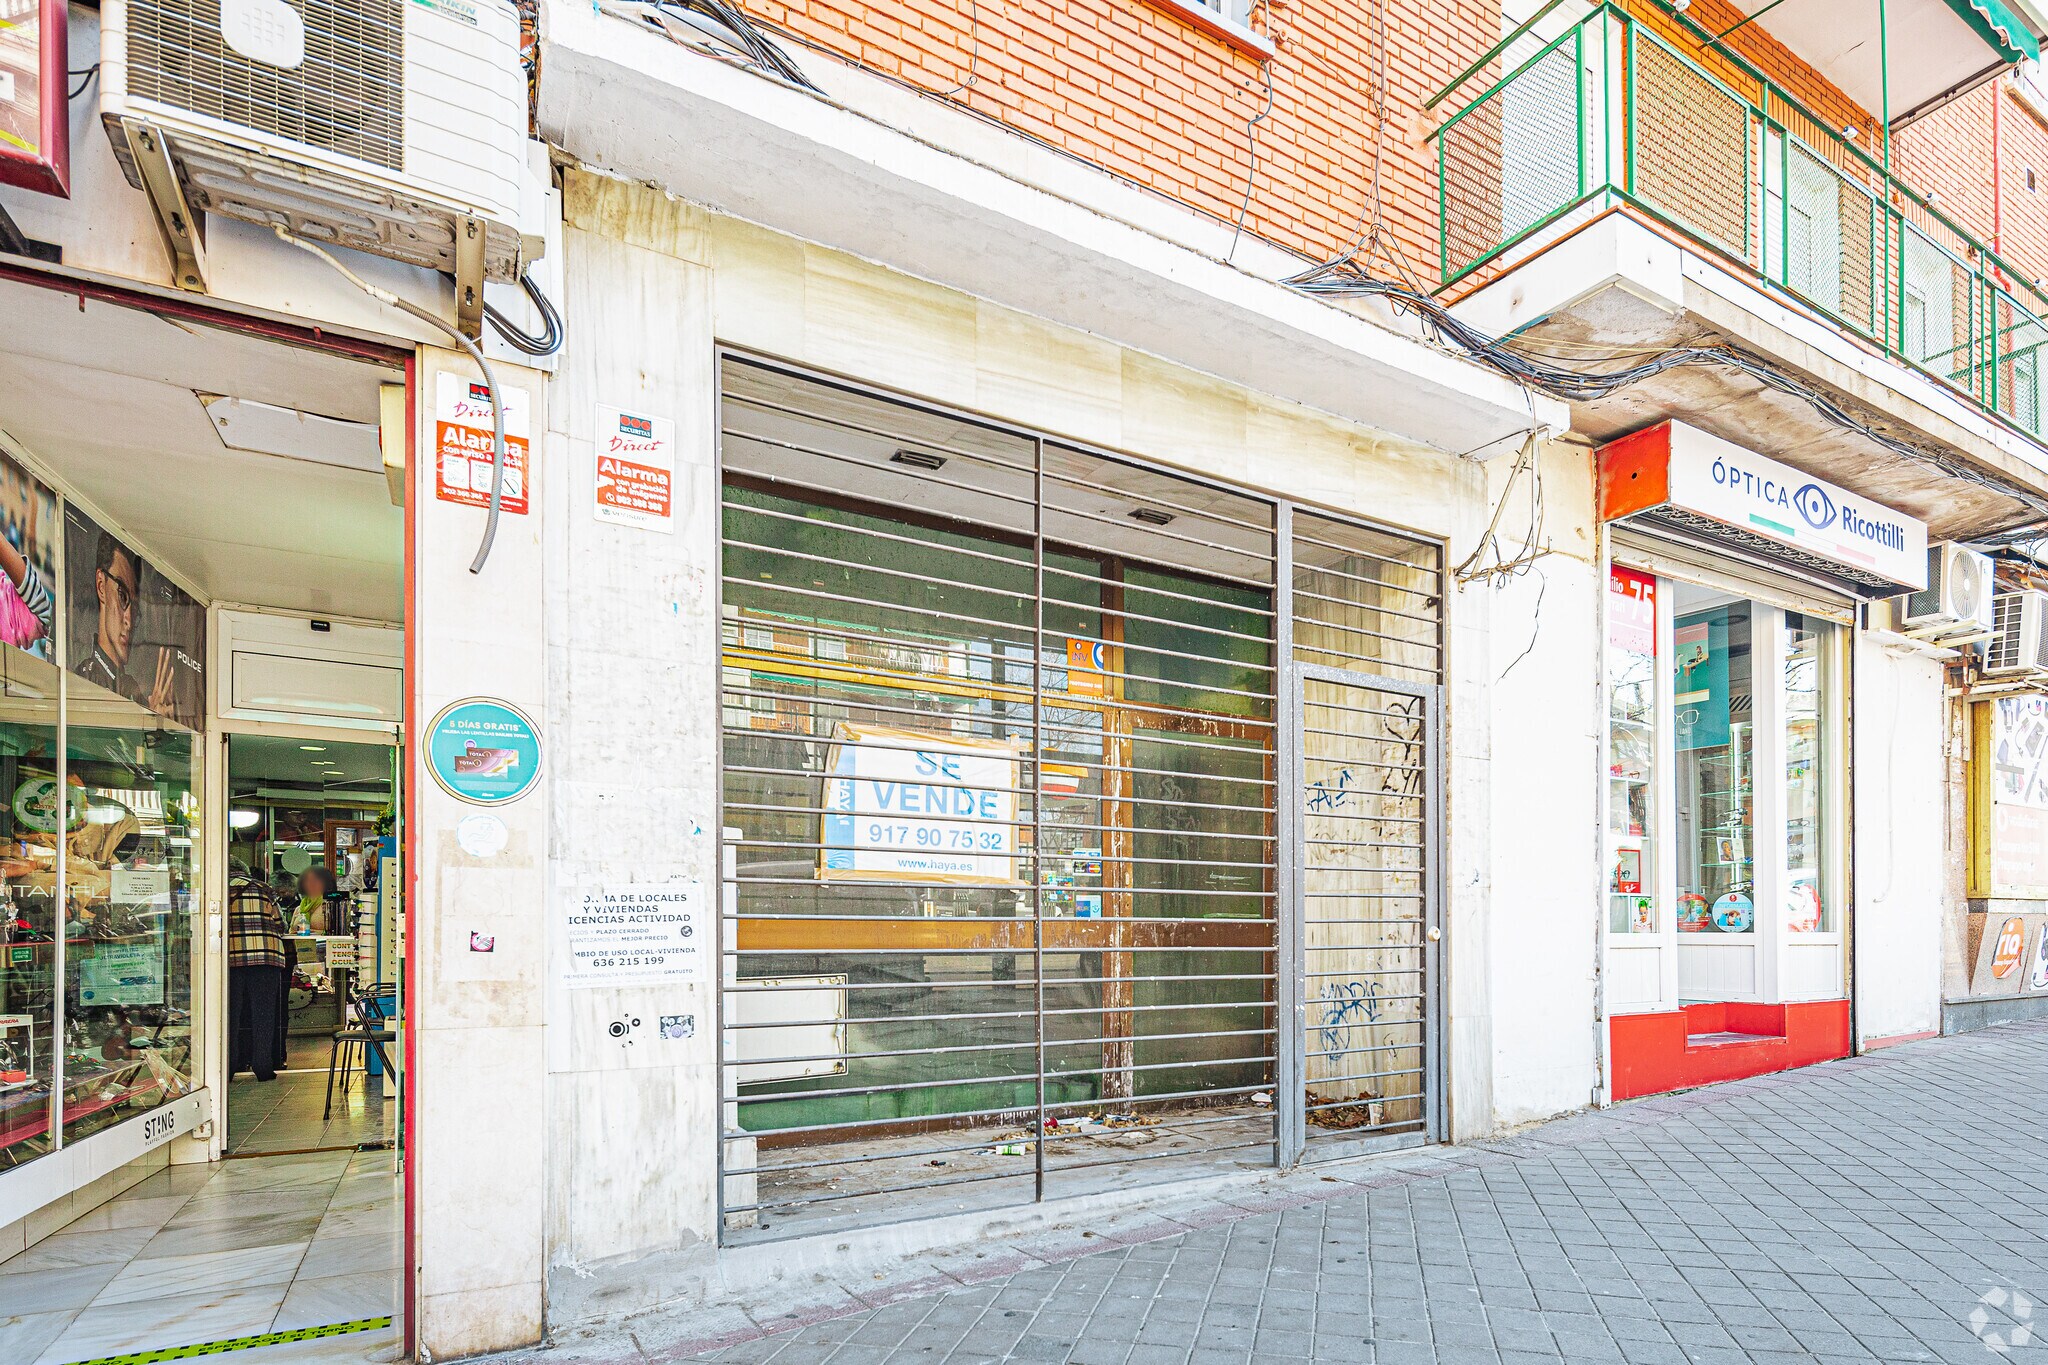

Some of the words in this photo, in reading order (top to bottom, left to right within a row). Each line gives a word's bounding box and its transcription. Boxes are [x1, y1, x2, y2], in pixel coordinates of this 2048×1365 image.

[620, 426, 652, 438] SECURITAS
[609, 436, 665, 452] Direct
[600, 459, 668, 486] Alarma
[1712, 456, 1790, 509] ÓPTICA
[1842, 505, 1905, 552] Ricottilli
[1630, 579, 1654, 625] 75
[177, 650, 202, 673] POLICE
[449, 720, 456, 728] 5
[457, 719, 481, 729] DÍAS
[915, 751, 961, 780] SE
[873, 781, 998, 819] VENDE
[869, 824, 909, 844] 917
[916, 827, 942, 846] 90
[950, 829, 973, 848] 75
[979, 831, 1002, 850] 32
[897, 858, 973, 872] www.haya.es
[594, 905, 659, 914] VIVIENDAS
[621, 894, 635, 902] DE
[639, 894, 687, 902] LOCALES
[628, 914, 691, 923] ACTIVIDAD
[1996, 922, 2020, 956] ria
[593, 959, 615, 967] 636
[619, 958, 640, 966] 215
[644, 957, 665, 965] 199
[630, 947, 696, 956] LOCAL-VIVIENDA
[199, 1341, 248, 1351] ESPERE
[309, 1325, 355, 1335] TURNO
